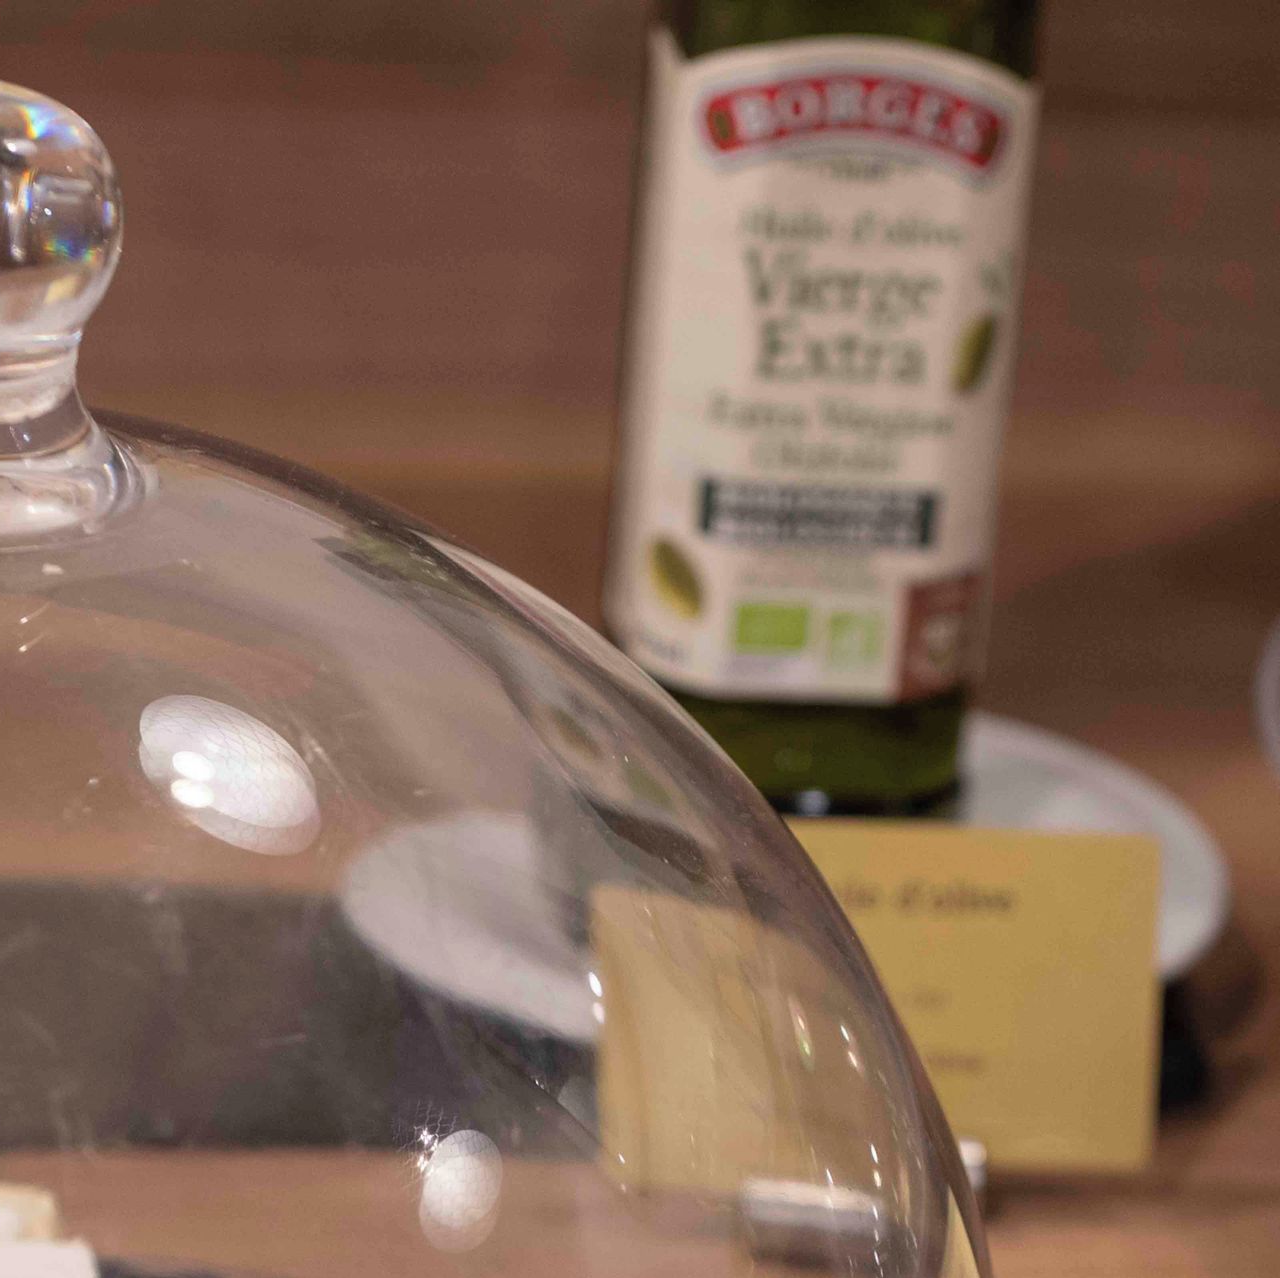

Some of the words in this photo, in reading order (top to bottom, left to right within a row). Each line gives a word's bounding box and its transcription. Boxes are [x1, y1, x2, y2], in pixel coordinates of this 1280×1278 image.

[730, 79, 983, 157] BORGES
[745, 247, 943, 328] Vierge
[756, 317, 925, 384] Extra
